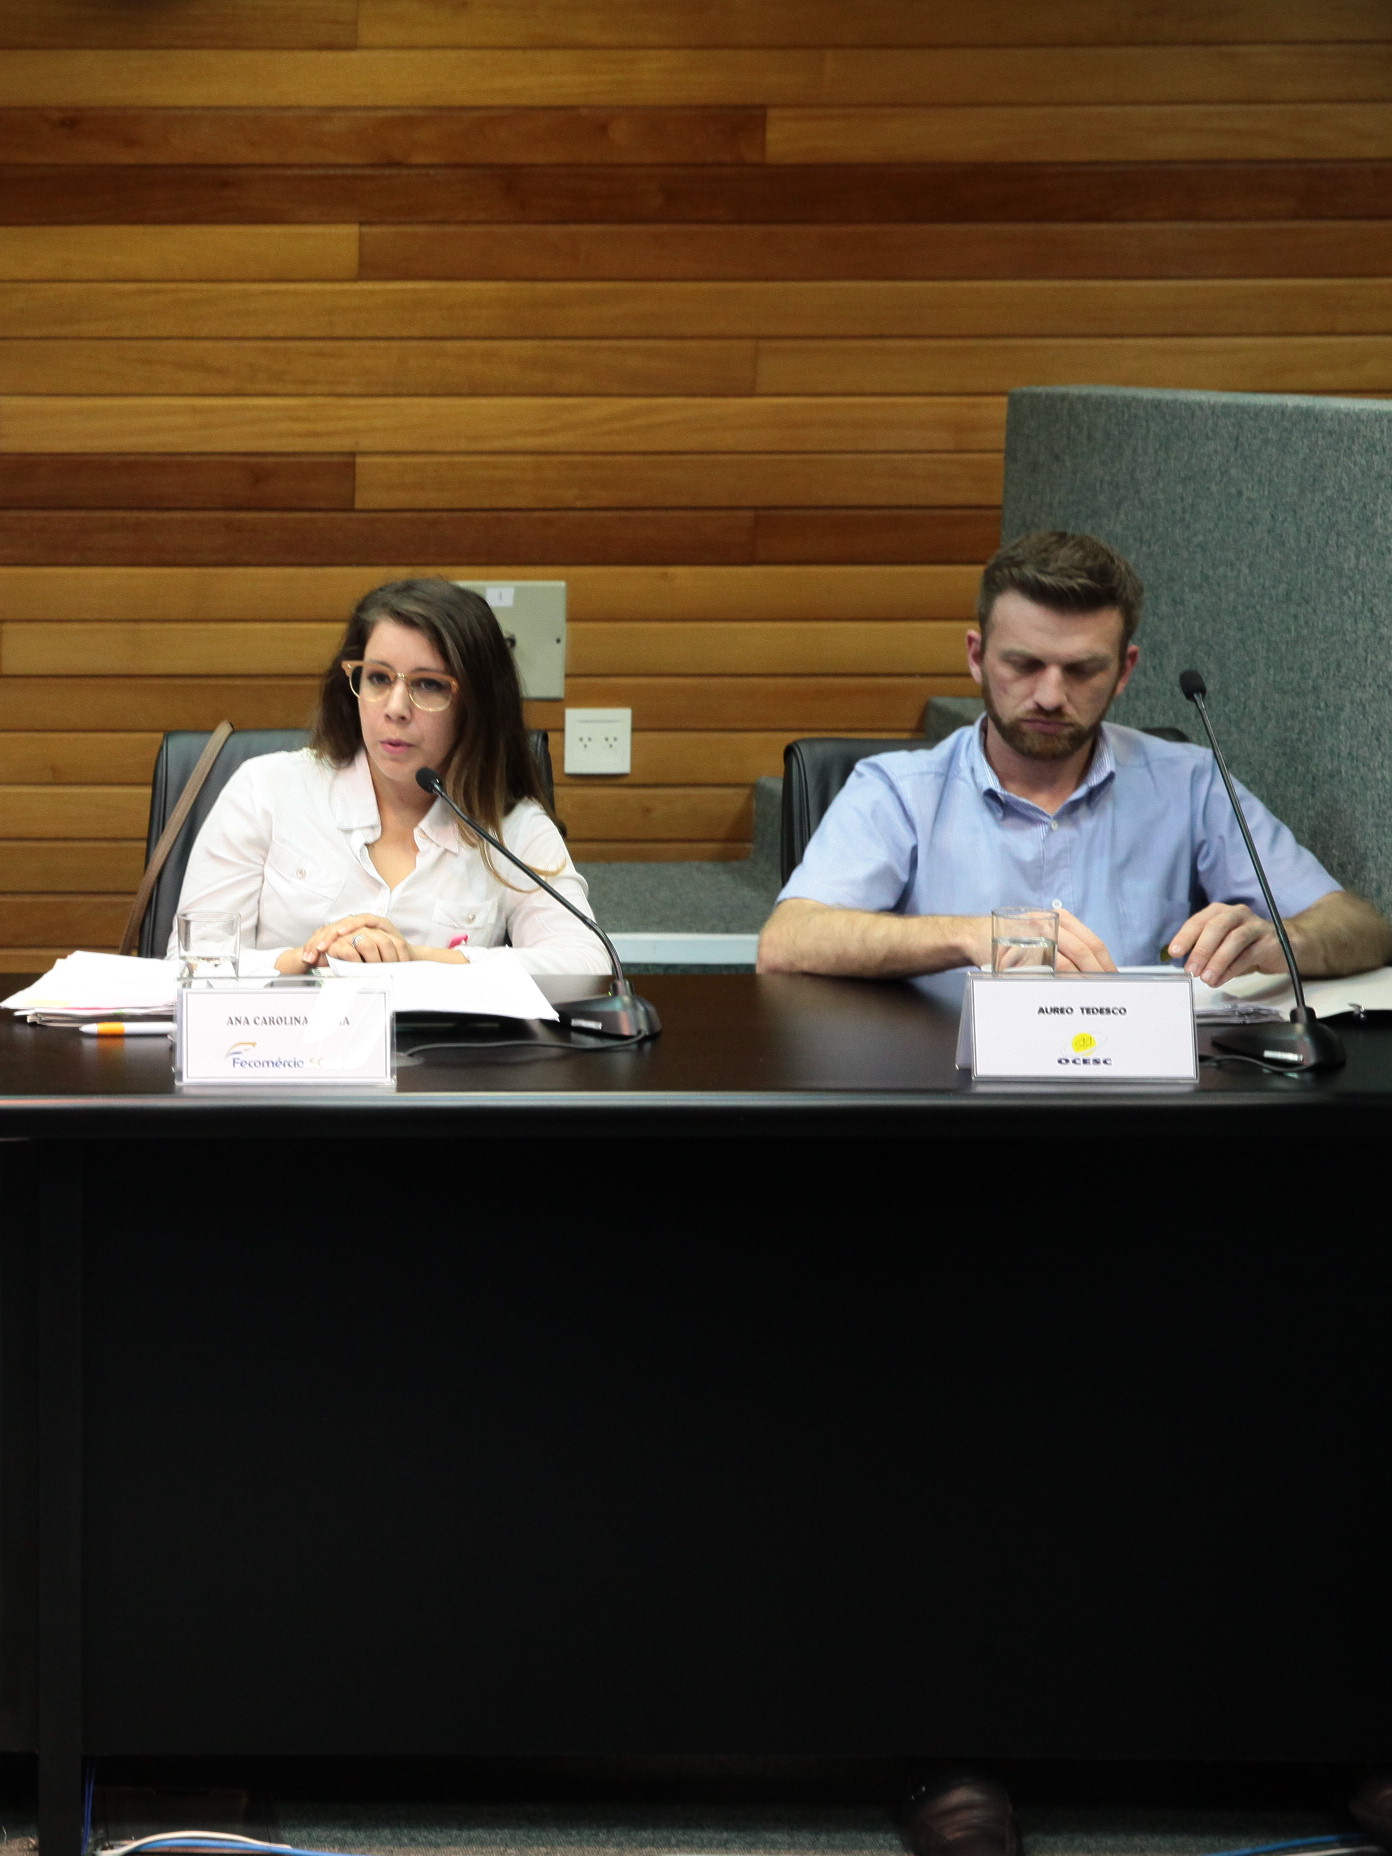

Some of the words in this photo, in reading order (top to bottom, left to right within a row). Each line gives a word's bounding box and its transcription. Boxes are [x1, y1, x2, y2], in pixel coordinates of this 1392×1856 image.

[1037, 1006, 1074, 1015] AUREO
[1079, 1006, 1127, 1015] TEDESCO
[226, 1016, 250, 1026] ANA
[253, 1016, 309, 1026] CAROLINA
[232, 1056, 305, 1069] Fecomércio
[1057, 1057, 1113, 1066] OCESC
